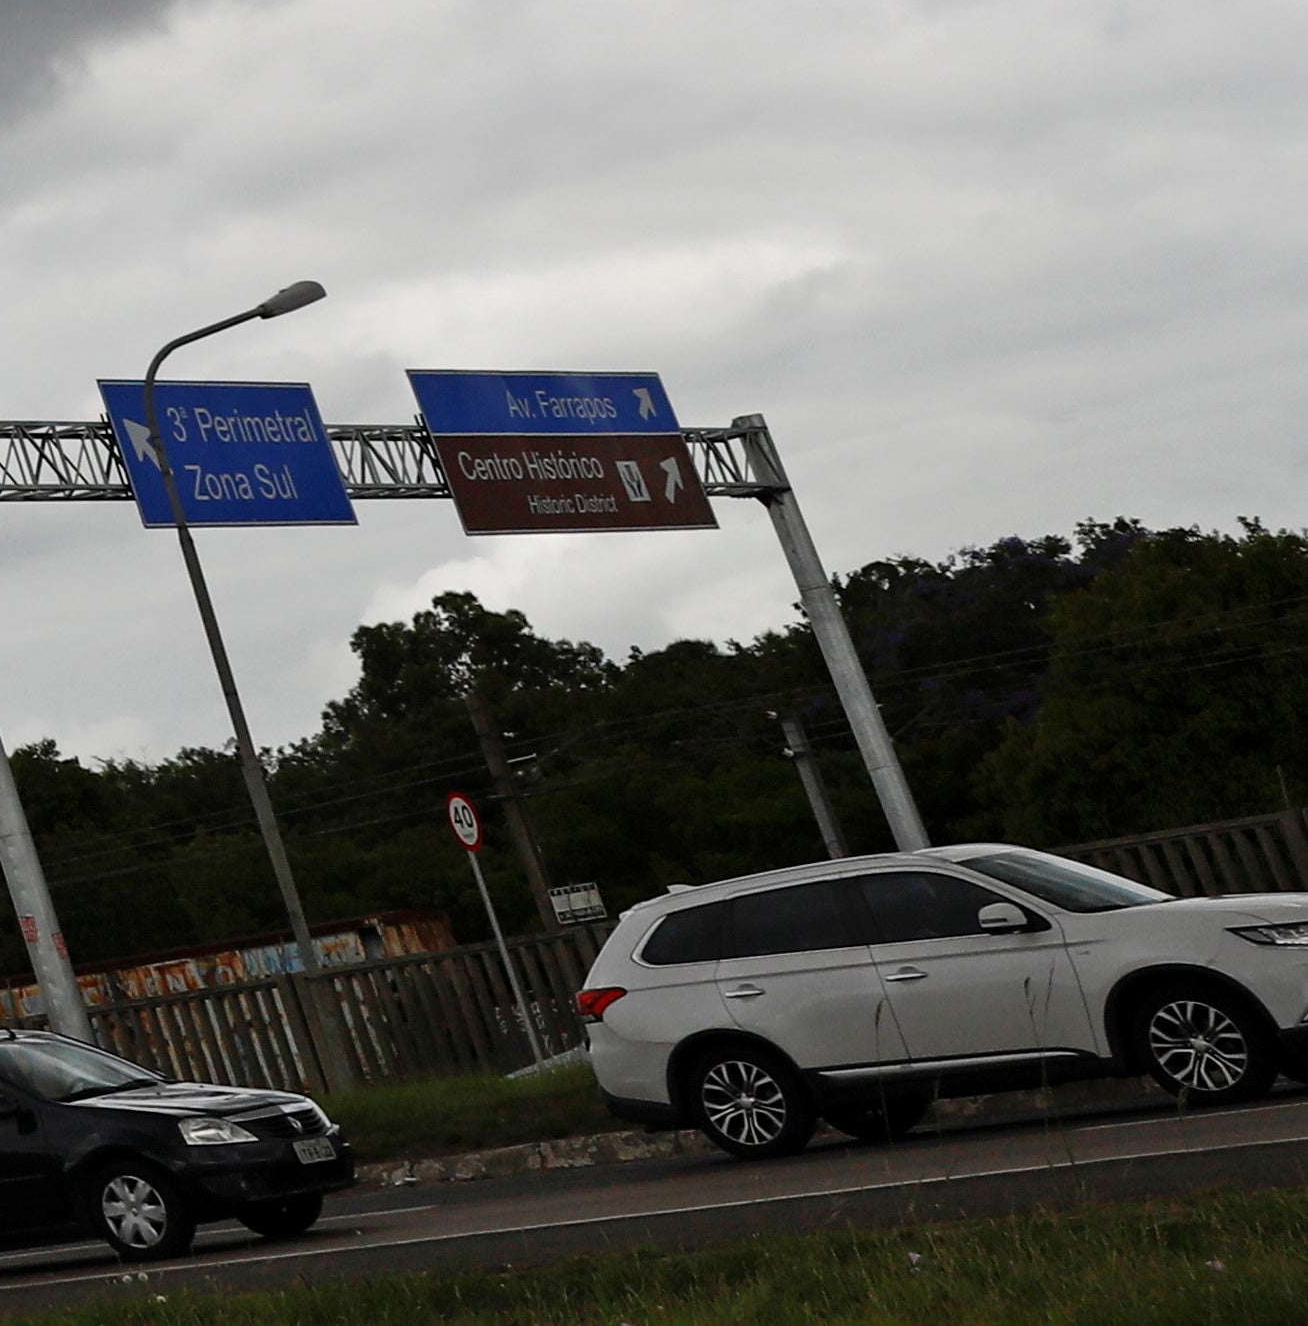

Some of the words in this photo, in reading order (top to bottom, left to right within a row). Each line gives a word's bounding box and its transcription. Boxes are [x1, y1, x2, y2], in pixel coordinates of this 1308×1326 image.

[506, 390, 536, 419] Av.
[536, 391, 618, 424] Farrapos
[194, 408, 318, 443] Perimetral
[458, 451, 524, 481] Centro
[522, 450, 604, 480] Histórico
[184, 465, 254, 501] Zona
[254, 464, 298, 500] Sul
[528, 494, 576, 515] Historic
[574, 494, 618, 514] District
[454, 805, 474, 829] 40
